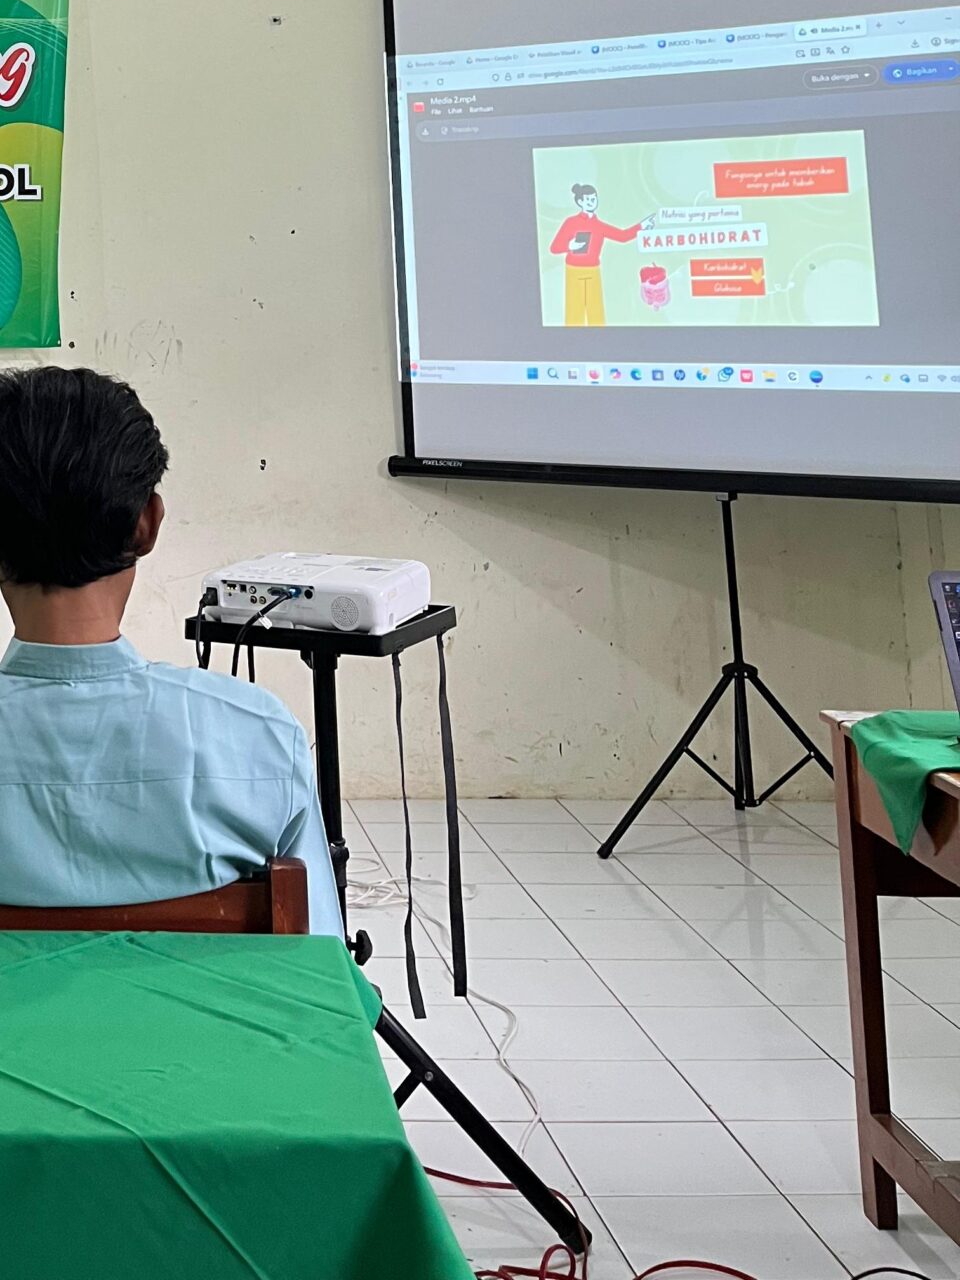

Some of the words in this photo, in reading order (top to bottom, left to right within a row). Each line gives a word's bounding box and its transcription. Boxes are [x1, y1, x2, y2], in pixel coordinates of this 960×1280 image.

[907, 66, 938, 77] Bagikan
[811, 73, 830, 83] Buka
[831, 72, 859, 82] dengan
[430, 96, 453, 105] Media
[453, 94, 477, 104] 2.mp4
[688, 211, 706, 222] yang
[642, 228, 762, 248] KARBOHIDRAT
